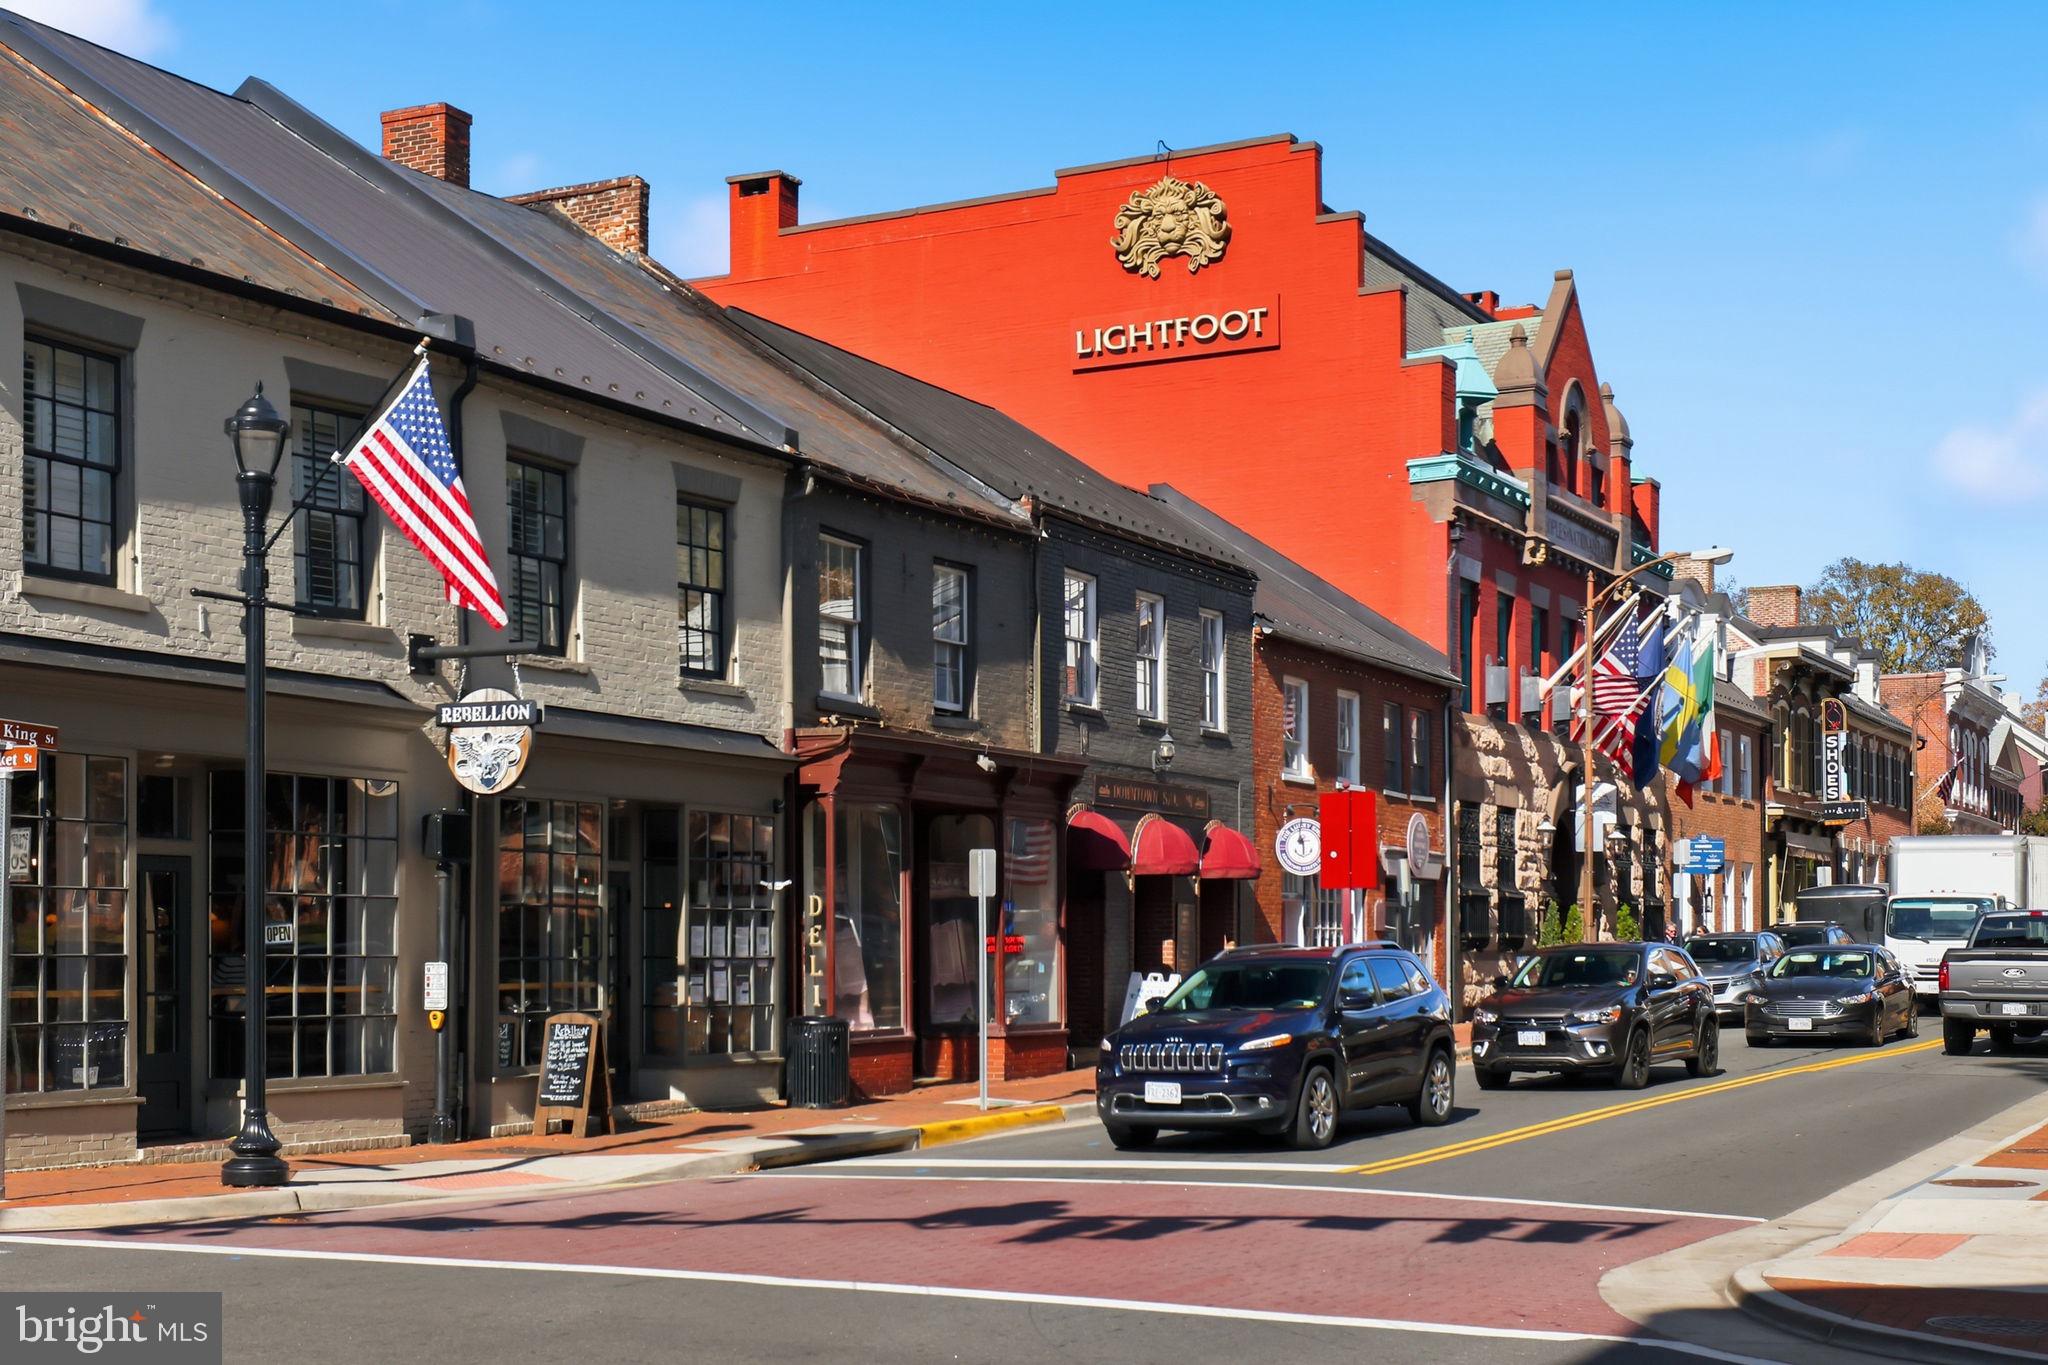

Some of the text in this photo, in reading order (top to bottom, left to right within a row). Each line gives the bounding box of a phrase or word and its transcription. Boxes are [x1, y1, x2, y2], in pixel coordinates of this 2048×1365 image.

[1076, 307, 1268, 355] LIGHTFOOT
[441, 703, 530, 723] REBELLION
[3, 723, 54, 747] King St
[24, 753, 33, 763] St
[1826, 735, 1838, 800] SHOES
[266, 926, 291, 942] OPEN
[808, 893, 824, 1007] DELI
